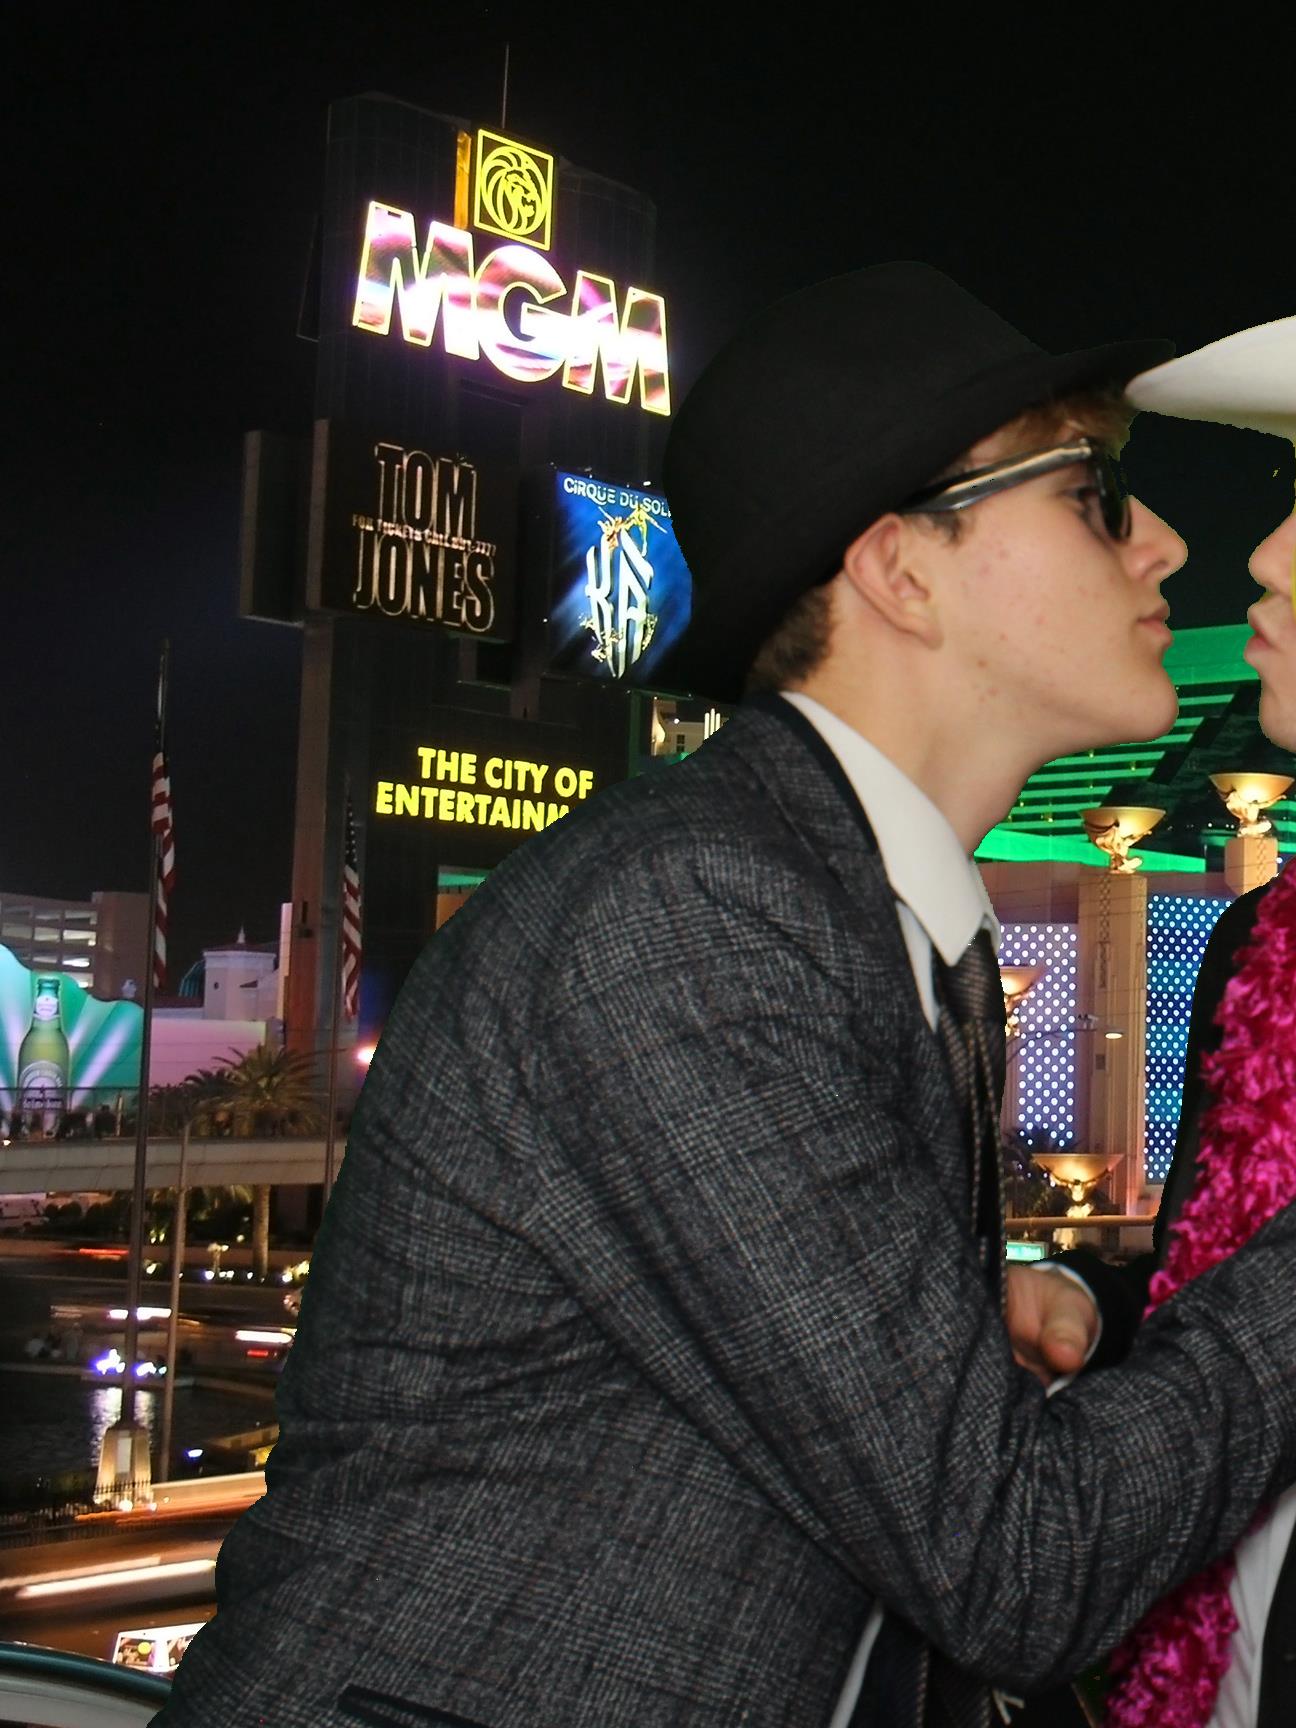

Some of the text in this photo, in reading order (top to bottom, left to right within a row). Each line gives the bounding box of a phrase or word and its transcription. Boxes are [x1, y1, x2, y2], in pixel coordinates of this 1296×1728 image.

[352, 200, 671, 416] MGM
[374, 442, 477, 538] TOM
[353, 530, 495, 632] JONES
[417, 747, 594, 800] THE CITY OF
